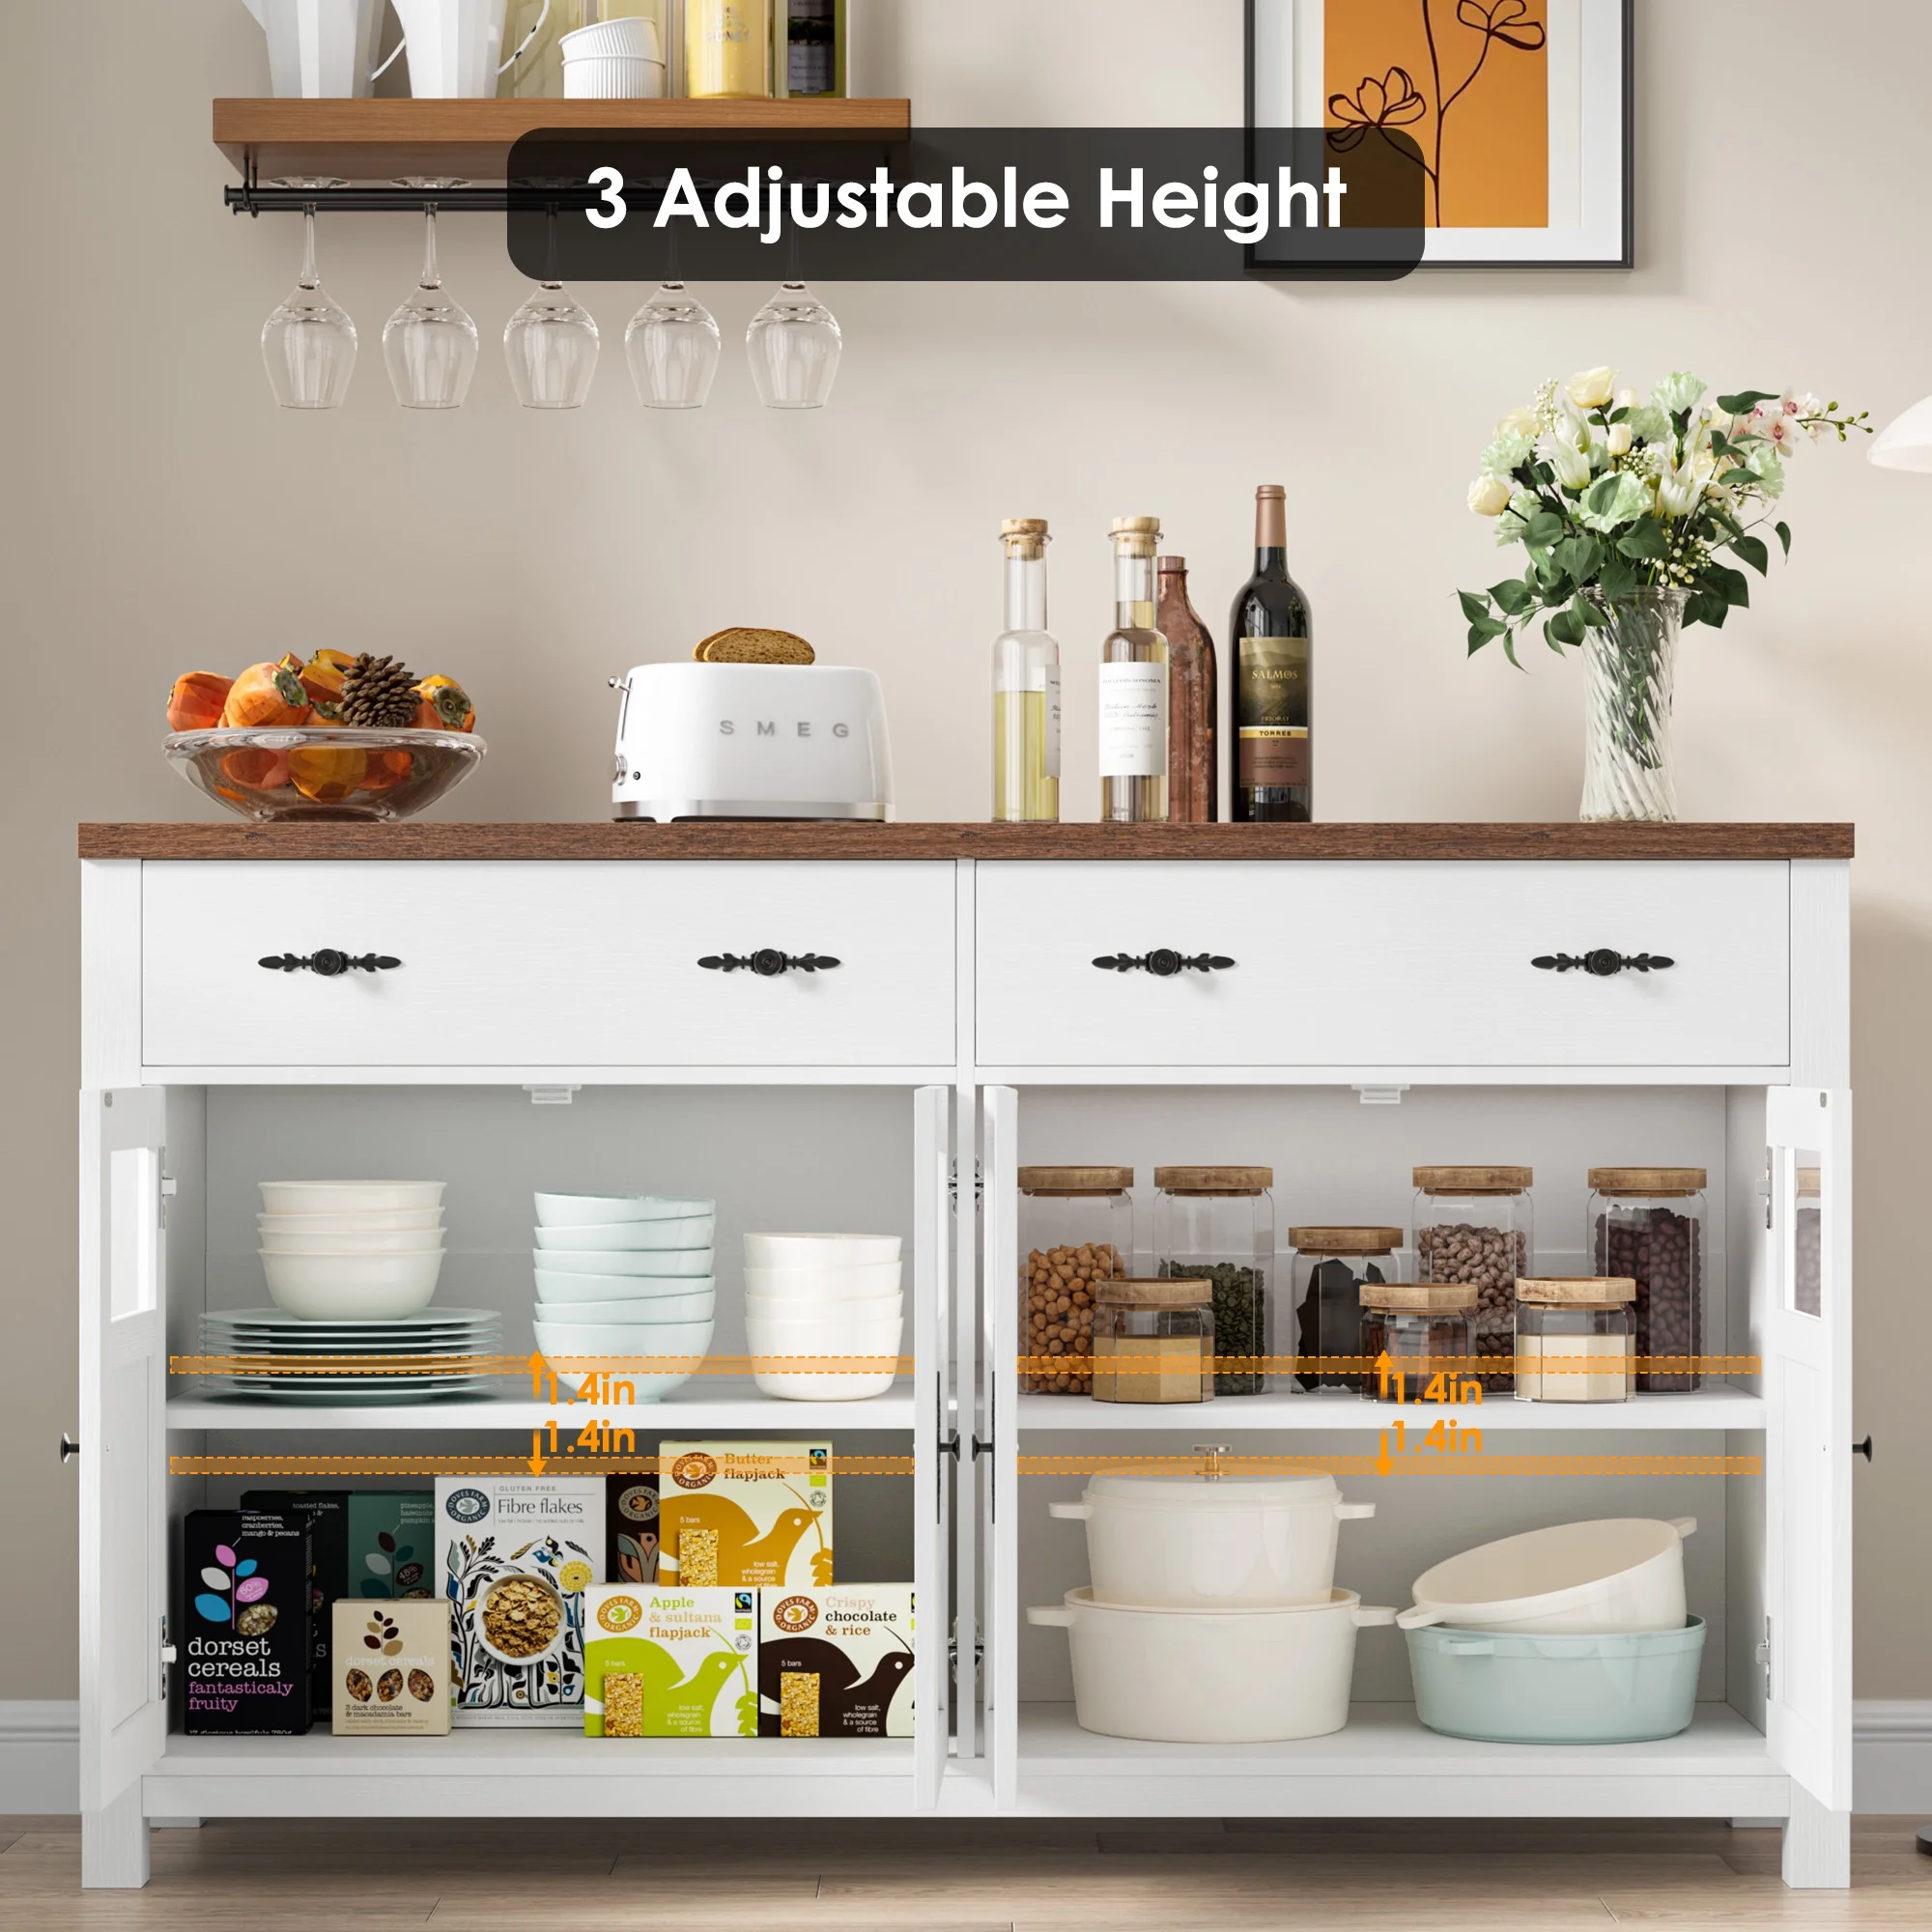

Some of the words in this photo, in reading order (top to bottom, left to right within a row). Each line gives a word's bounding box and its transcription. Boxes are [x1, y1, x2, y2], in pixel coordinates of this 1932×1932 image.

[1252, 668, 1298, 680] SALMOS
[719, 720, 849, 738] SMEG
[724, 1453, 773, 1465] Butter
[724, 1468, 785, 1482] flapjack
[448, 1491, 470, 1508] DOVES
[469, 1491, 488, 1508] FARM
[498, 1498, 536, 1514] Fibre
[540, 1498, 582, 1514] flakes
[450, 1510, 487, 1522] ORGANIC
[599, 1598, 618, 1621] DOVES
[619, 1597, 639, 1611] FARM
[649, 1597, 695, 1611] Apple
[776, 1598, 794, 1622] DOVES
[795, 1597, 816, 1612] FARM
[825, 1597, 875, 1610] Crispy
[604, 1614, 639, 1631] ORGANIC
[648, 1612, 661, 1623] &
[665, 1612, 723, 1623] sultana
[825, 1610, 897, 1622] chocolate
[781, 1615, 815, 1632] ORGANIC
[825, 1625, 838, 1635] &
[841, 1625, 871, 1635] rice
[649, 1627, 711, 1641] flapjack
[187, 1636, 271, 1657] dorset
[345, 1656, 386, 1665] dorset
[388, 1656, 435, 1665] cereals
[187, 1659, 282, 1678] cereals
[188, 1681, 294, 1697] fantasticaly
[188, 1697, 239, 1713] fruity
[867, 1704, 882, 1713] salt,
